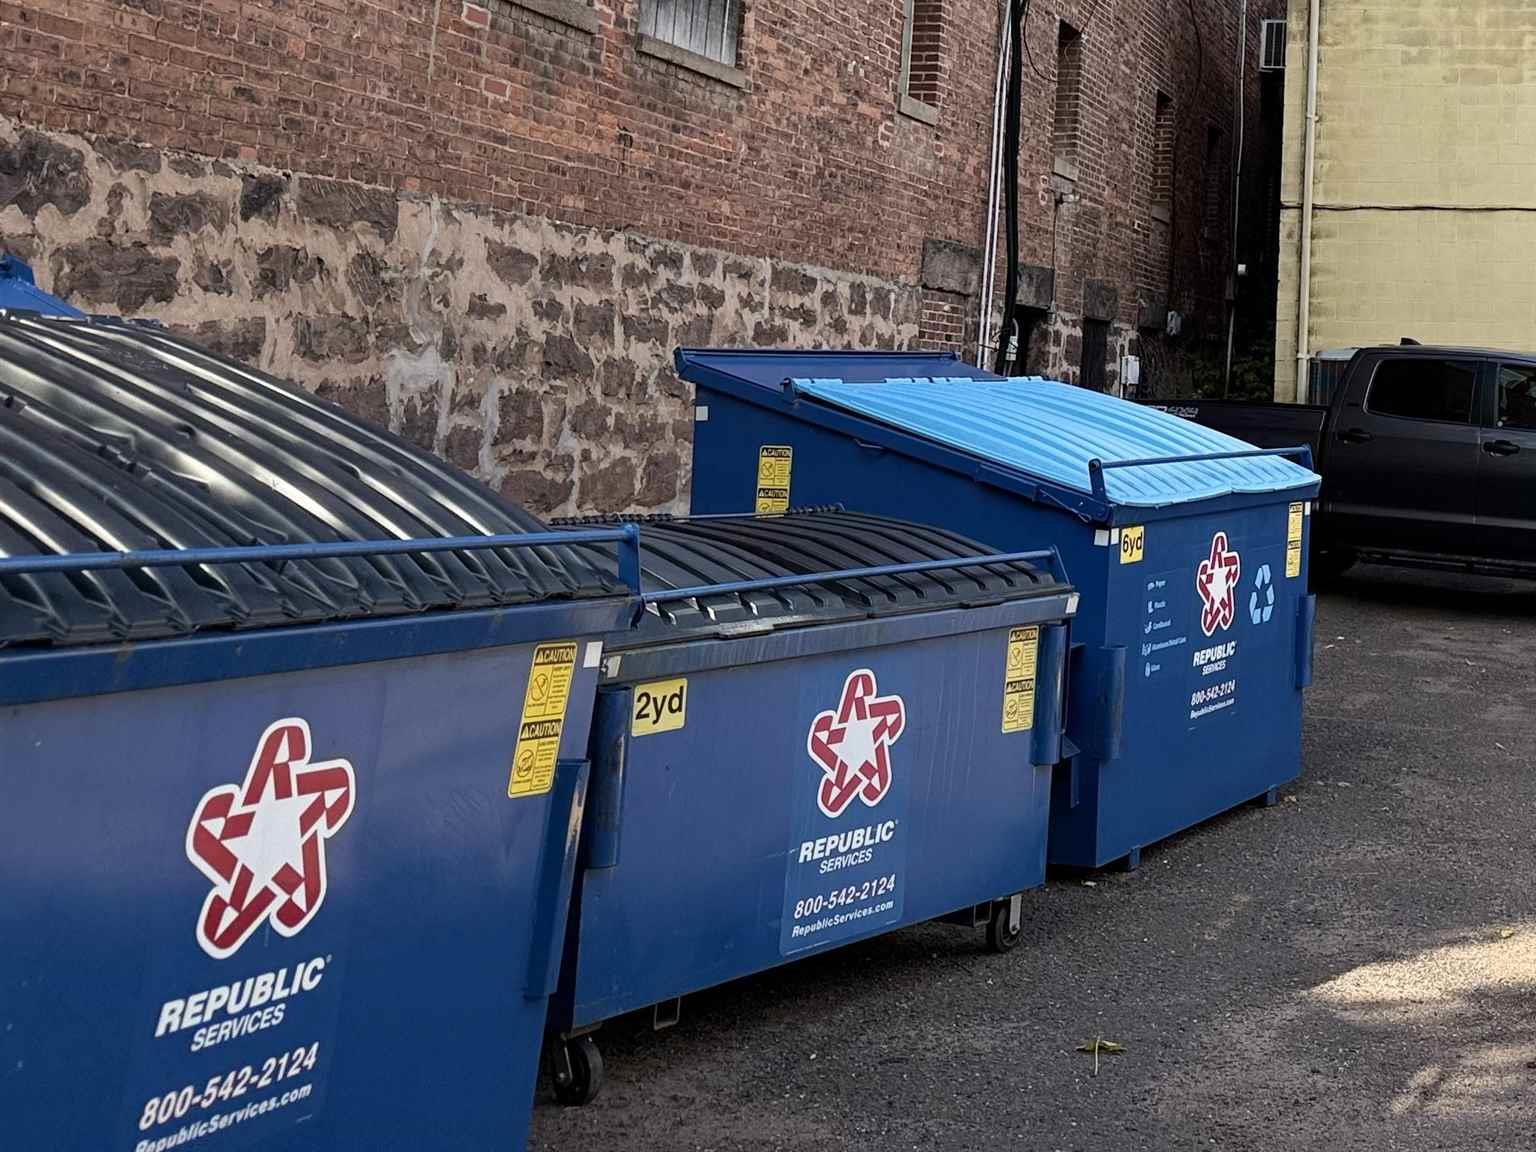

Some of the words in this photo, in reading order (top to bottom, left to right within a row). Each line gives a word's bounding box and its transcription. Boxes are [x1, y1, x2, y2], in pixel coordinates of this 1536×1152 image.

[1122, 531, 1143, 557] 6yd
[544, 647, 575, 663] CAUTION
[1192, 640, 1236, 667] REPUBLIC
[1202, 659, 1227, 676] SERVICES
[635, 685, 684, 725] 2yd
[1190, 679, 1236, 706] 800-542-2124
[529, 721, 561, 738] CAUTION
[798, 820, 895, 863] REPUBLIC
[819, 848, 873, 874] SERVICES
[793, 873, 896, 920] 800-542-2124
[791, 900, 894, 938] RepublicServices.com
[154, 956, 326, 1037] REPUBLIC
[190, 1003, 286, 1052] SERVICES
[138, 1041, 320, 1131] 800-542-2124
[135, 1083, 313, 1152] RepublicServices.com
